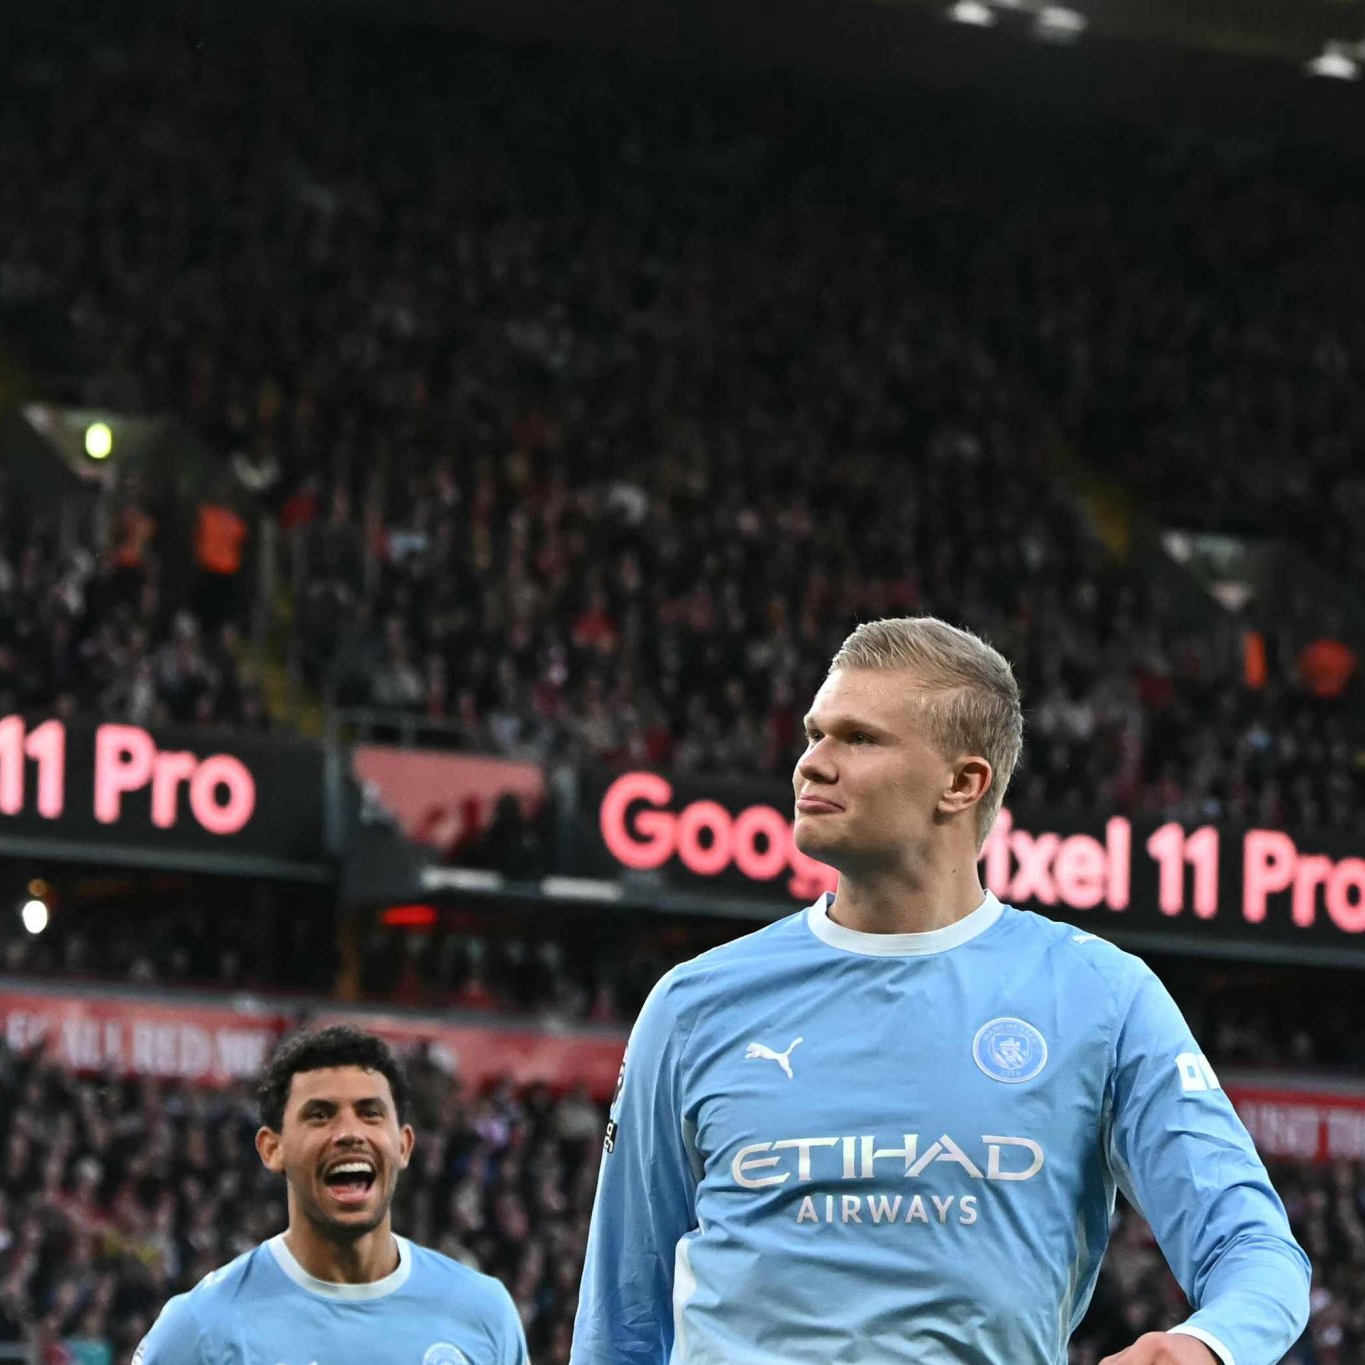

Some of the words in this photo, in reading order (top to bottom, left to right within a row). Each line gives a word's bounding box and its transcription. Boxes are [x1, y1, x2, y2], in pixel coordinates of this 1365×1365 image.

[94, 723, 256, 835] Pro
[599, 770, 840, 899] Goo
[979, 808, 1132, 912] ixel
[1146, 821, 1220, 918] 11
[732, 1133, 1045, 1188] ETIHAD
[796, 1195, 978, 1226] AIRWAYS
